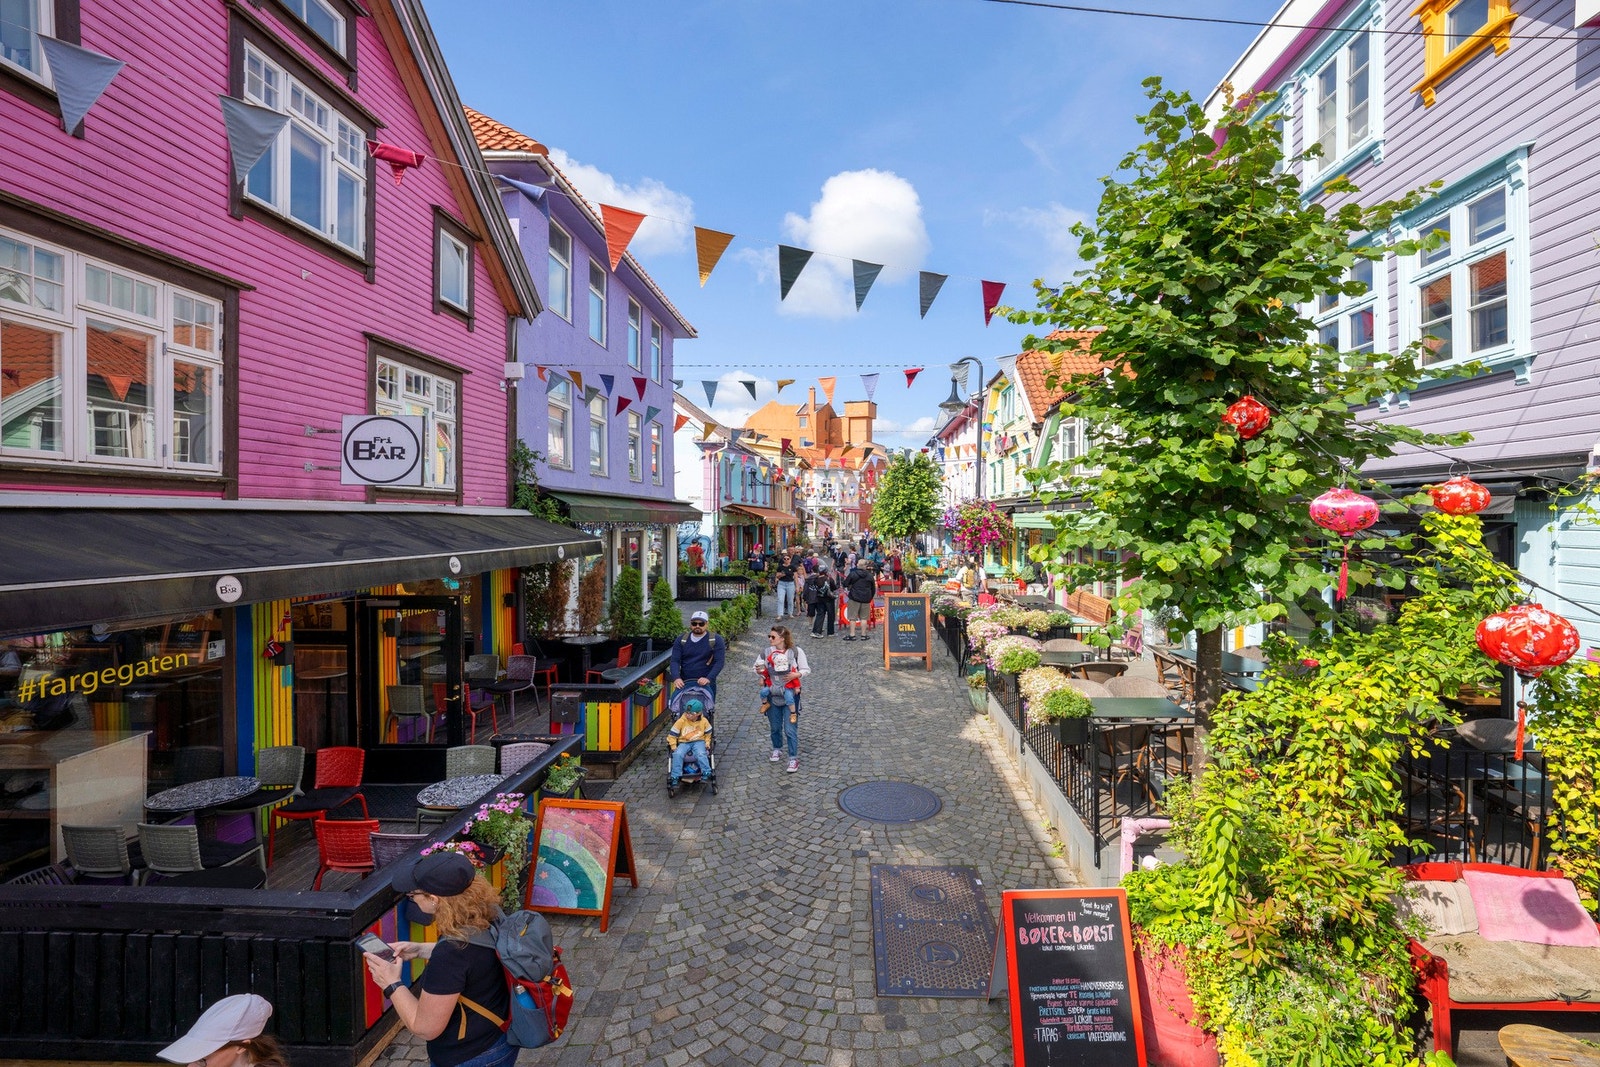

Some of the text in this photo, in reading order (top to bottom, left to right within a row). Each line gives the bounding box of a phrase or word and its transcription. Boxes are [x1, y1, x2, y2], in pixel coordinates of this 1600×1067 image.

[373, 436, 393, 444] Fri
[352, 440, 406, 461] BAR
[18, 653, 189, 703] #fargegaten
[1024, 911, 1076, 923] Velkommen til
[1018, 925, 1067, 945] BØKER
[1072, 924, 1115, 943] BØRST
[1035, 1027, 1059, 1042] TAPAS
